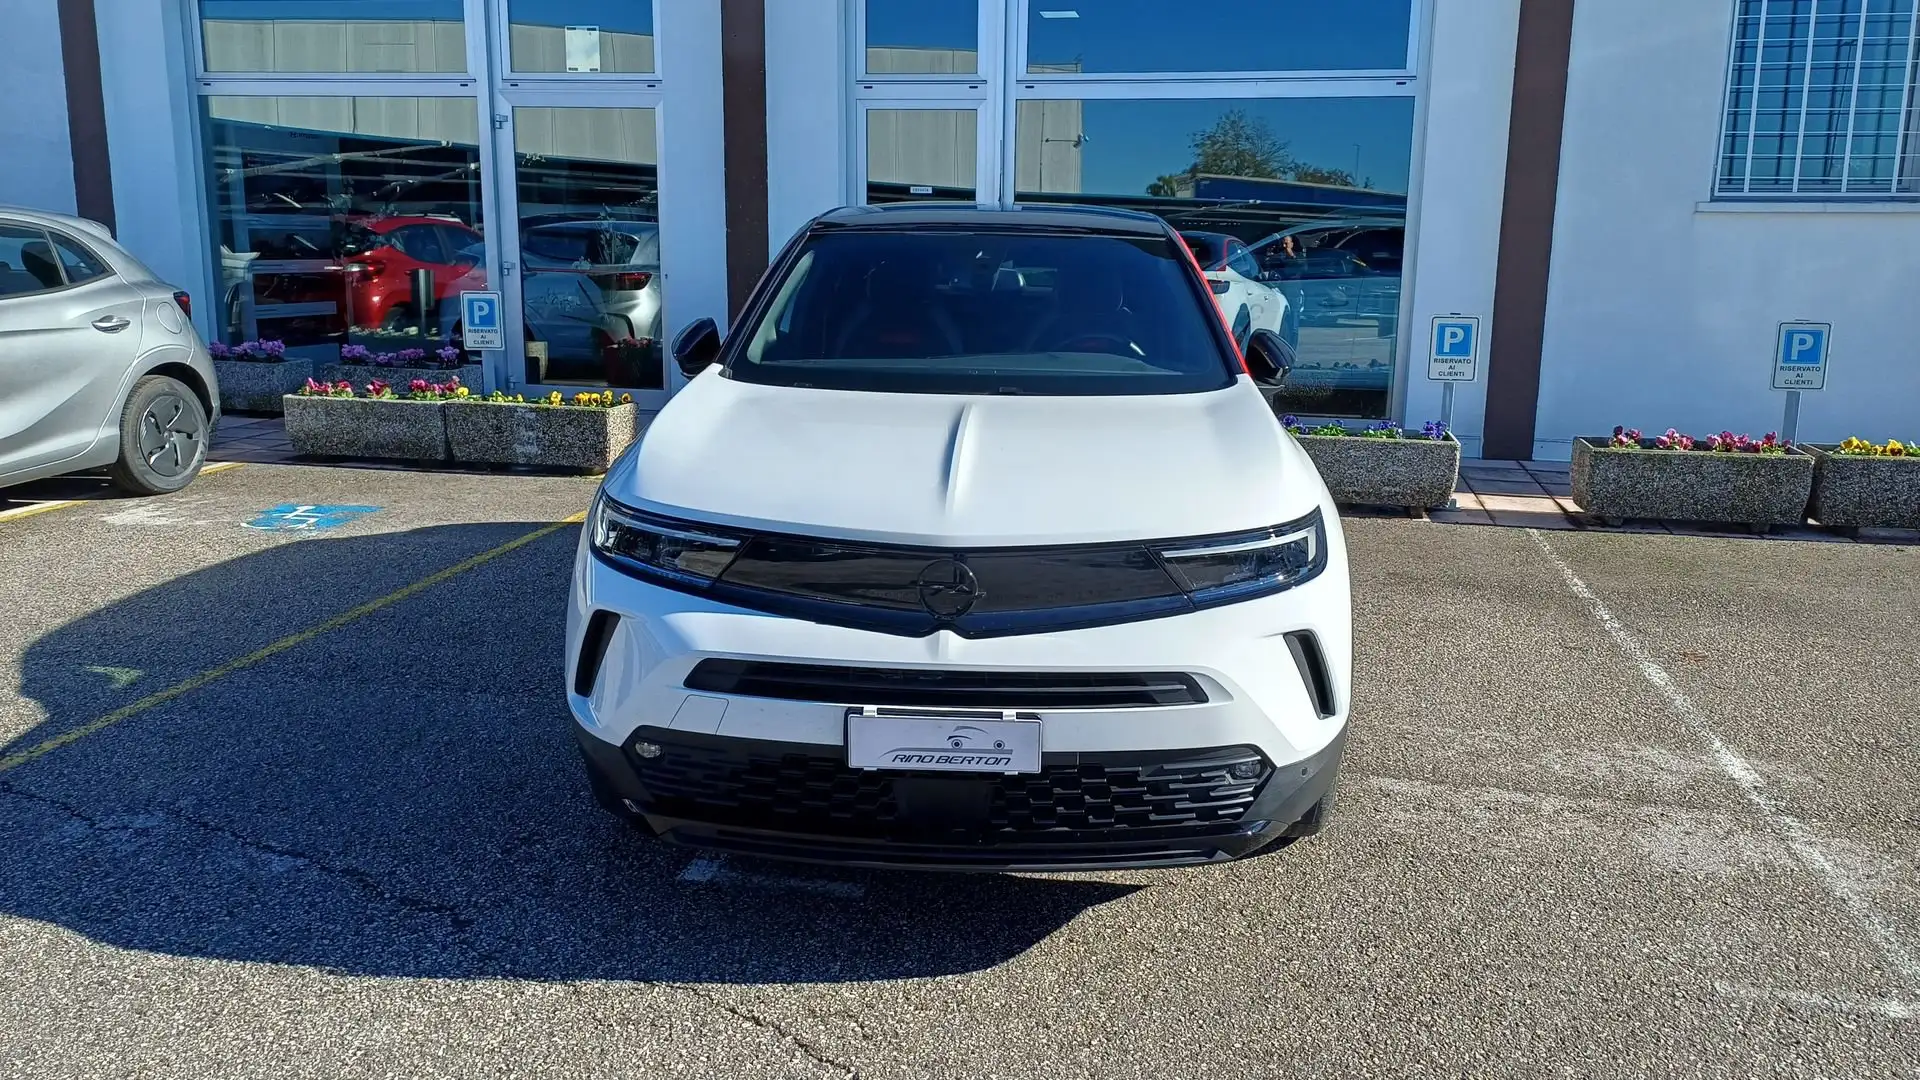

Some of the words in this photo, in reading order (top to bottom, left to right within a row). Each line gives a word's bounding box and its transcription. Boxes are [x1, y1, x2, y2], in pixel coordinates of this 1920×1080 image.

[473, 301, 490, 324] P
[1443, 326, 1464, 353] P
[1790, 333, 1814, 360] P
[891, 754, 936, 764] RINO
[935, 755, 1012, 766] BERTON
